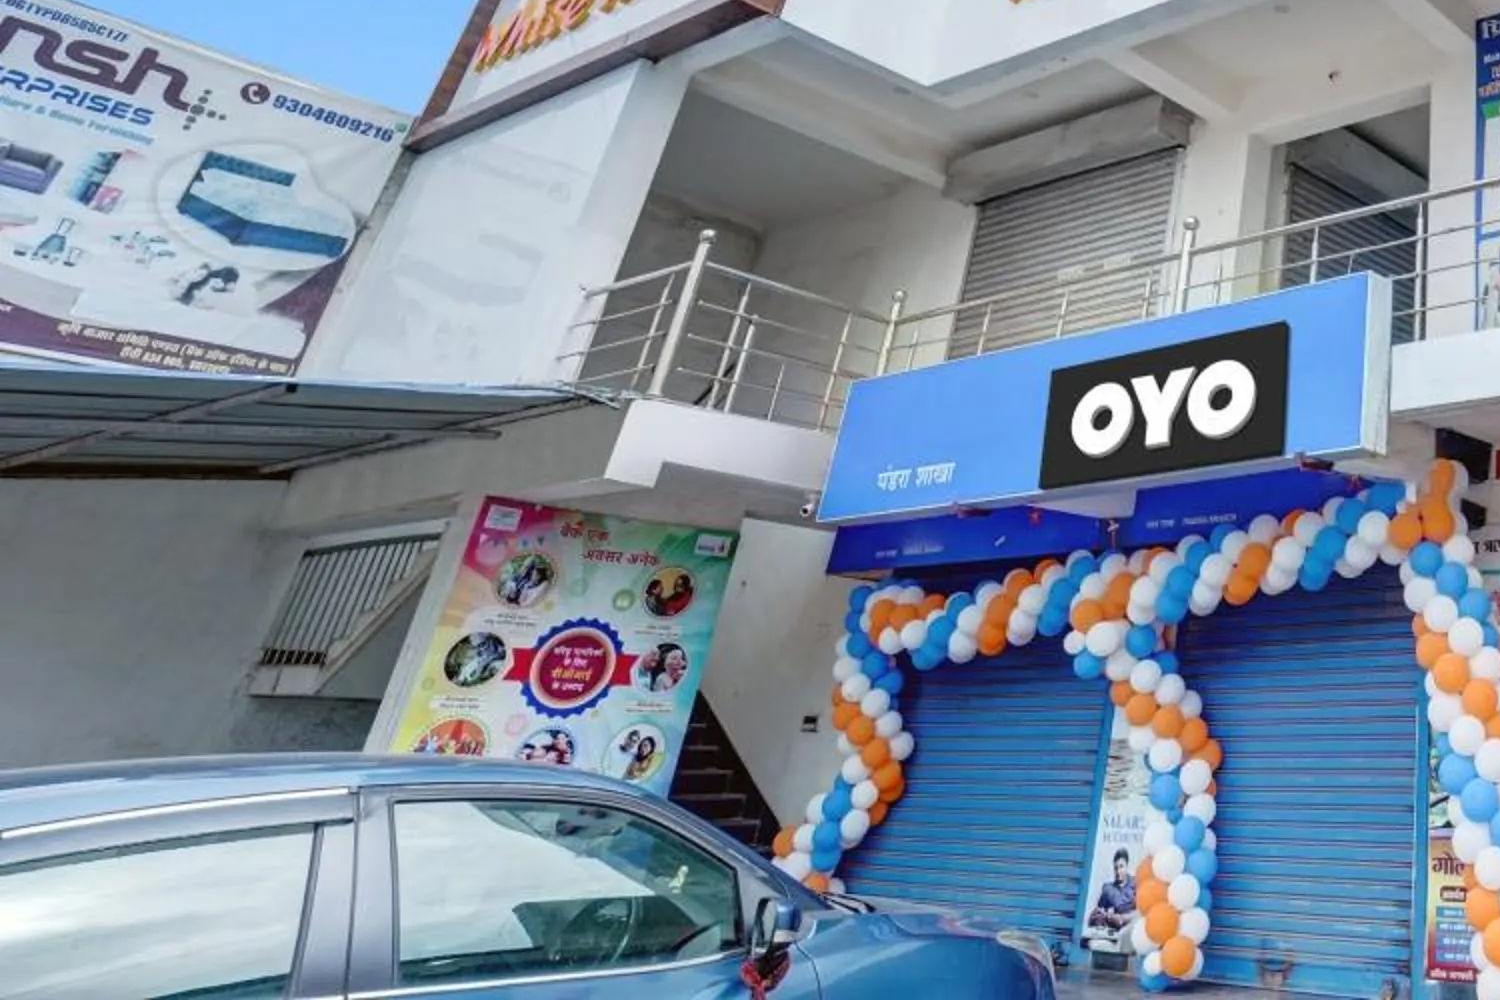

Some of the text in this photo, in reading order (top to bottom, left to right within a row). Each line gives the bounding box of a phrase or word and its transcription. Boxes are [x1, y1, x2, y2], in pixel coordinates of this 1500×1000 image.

[0, 66, 155, 126] RPRISES
[272, 93, 394, 144] 9304809216
[1071, 358, 1257, 458] OYO
[915, 462, 956, 488] शाखा
